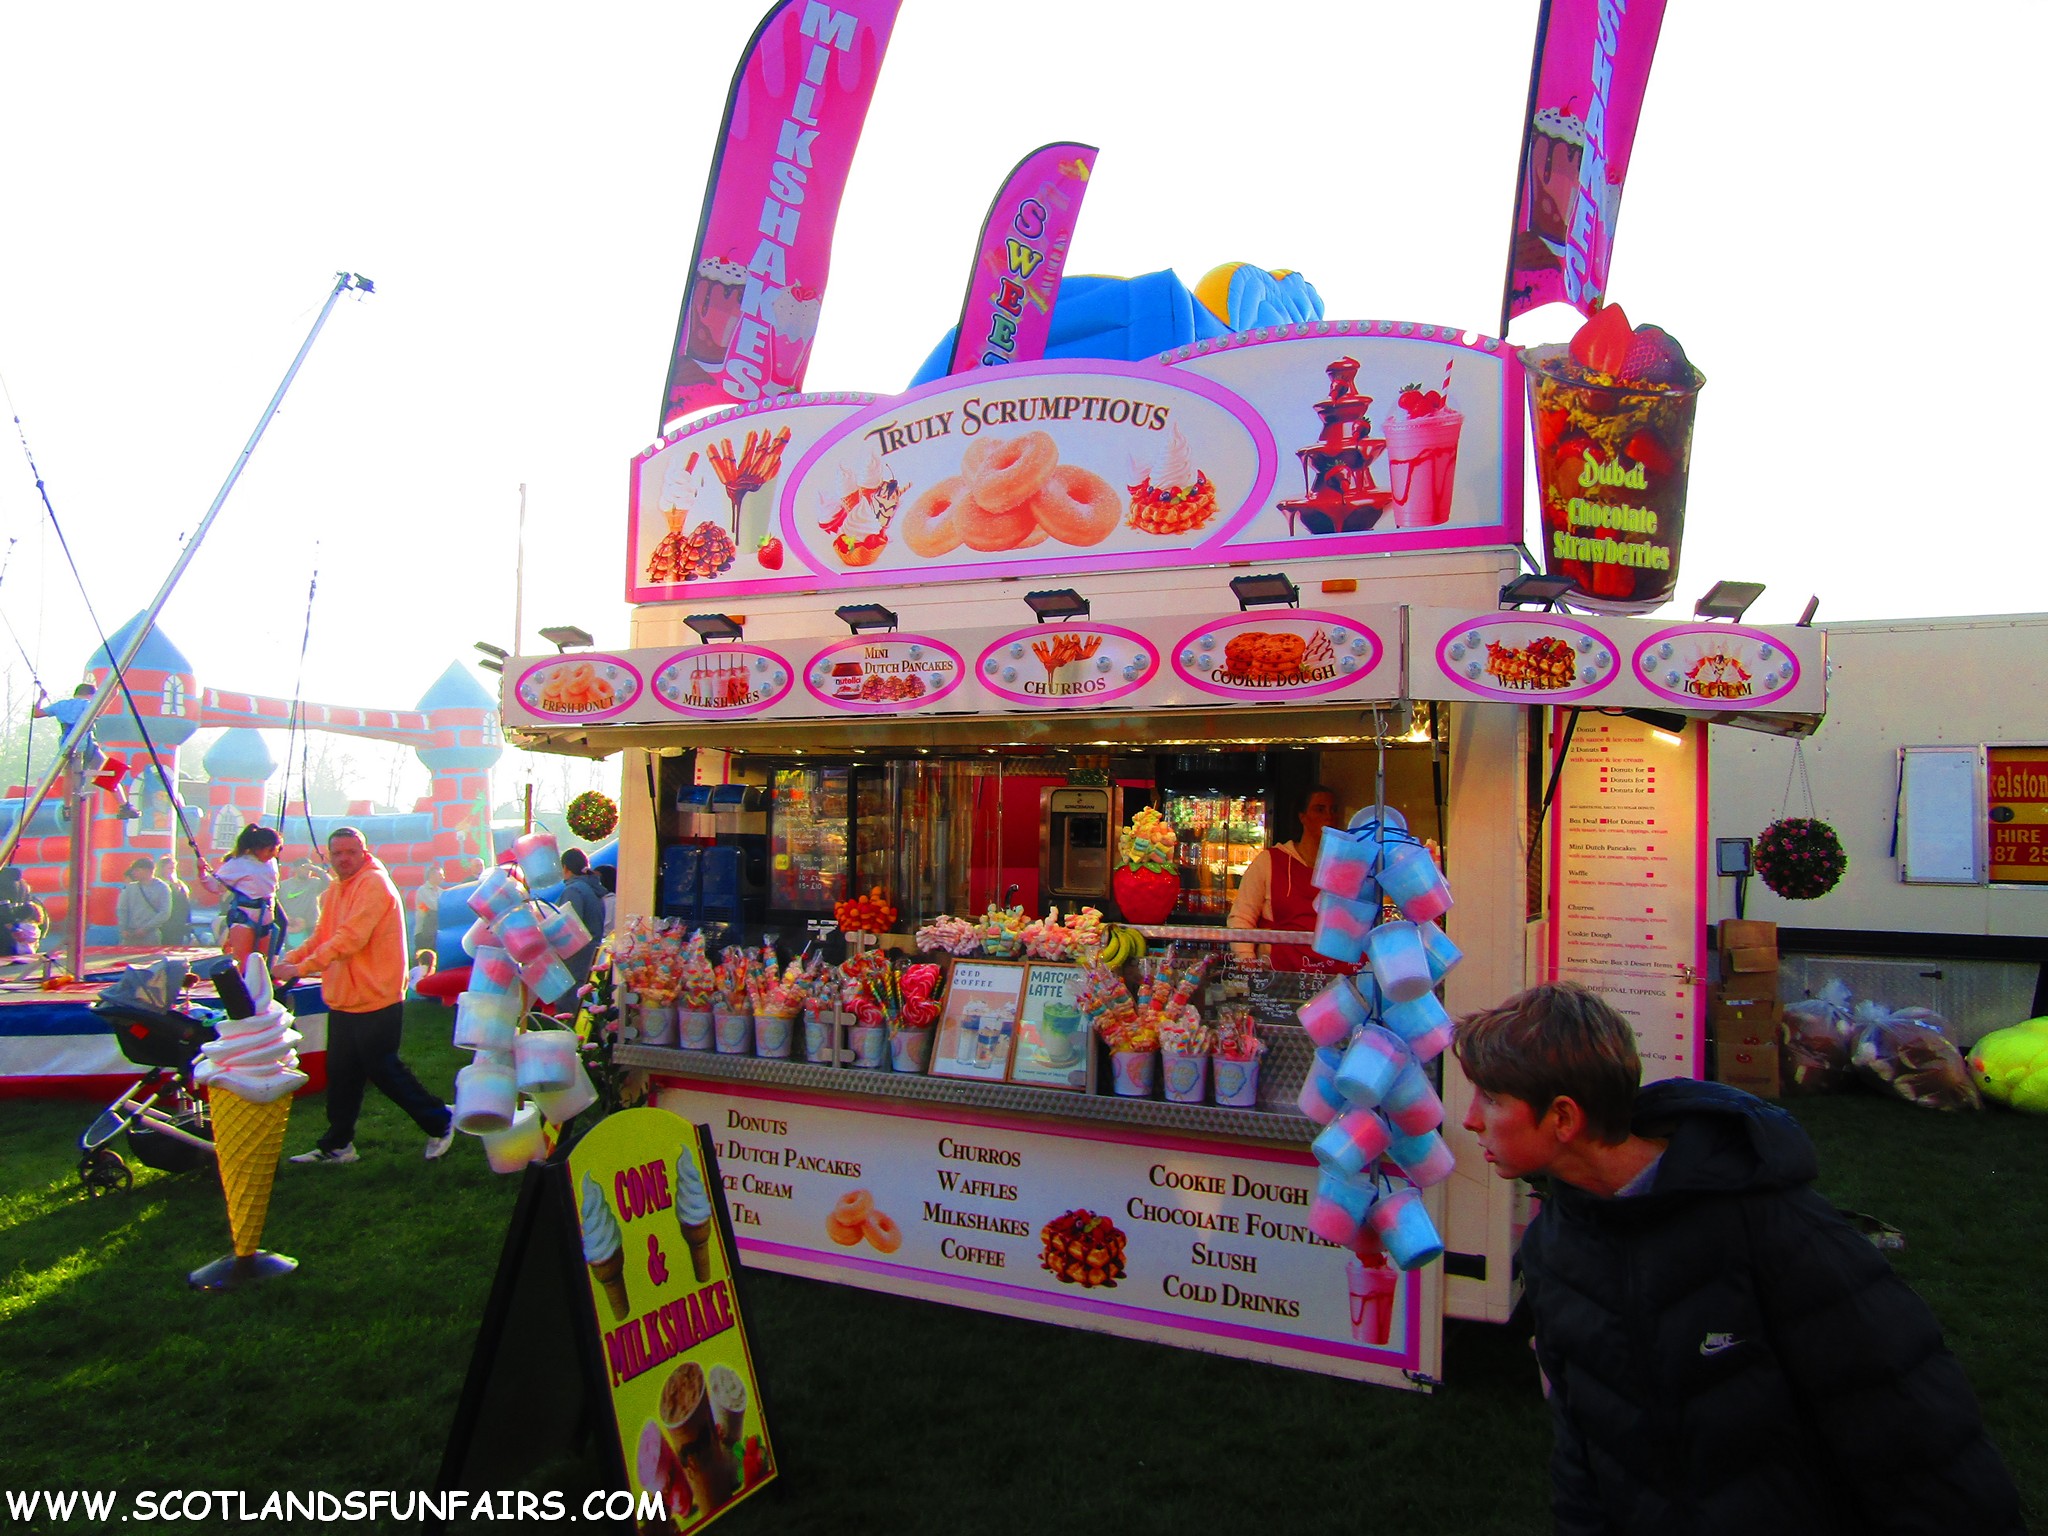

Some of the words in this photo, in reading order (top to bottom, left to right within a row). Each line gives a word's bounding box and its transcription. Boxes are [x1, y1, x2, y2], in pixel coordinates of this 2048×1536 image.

[1564, 0, 1627, 304] SHAKES
[723, 1, 858, 401] MILKSHAKES
[865, 411, 954, 456] TRULY
[961, 396, 1170, 436] SCRUMPTIOUS
[1578, 447, 1648, 490] Dubai
[1568, 497, 1658, 534] Chocolate
[1553, 530, 1670, 570] Strawberries
[864, 662, 899, 674] DUTCH
[901, 660, 953, 673] PANCAKES
[1211, 670, 1272, 688] COOKIE
[1276, 664, 1337, 687] DOUGH
[683, 690, 760, 708] MILKSHAKES
[1024, 677, 1106, 695] CHURROS
[1684, 680, 1706, 695] ICE
[1708, 682, 1753, 697] CREAM
[542, 699, 578, 713] FRESH
[578, 696, 615, 713] DONUT
[1606, 844, 1636, 852] Pancakes
[1997, 829, 2041, 843] HIRE
[1995, 846, 2017, 862] 87
[1567, 904, 1594, 912] Churros
[1567, 930, 1590, 938] Cookie
[1590, 931, 1612, 939] Dough
[1029, 985, 1063, 998] LATTE
[1630, 988, 1666, 997] TOPPINGS
[1652, 1052, 1667, 1060] Cup
[727, 1109, 788, 1135] DONUTS
[728, 1140, 780, 1166] DUTCH
[784, 1148, 861, 1178] PANCAKES
[938, 1137, 1021, 1167] CHURROS
[614, 1159, 672, 1223] CONE
[721, 1170, 738, 1190] CE
[742, 1173, 793, 1199] CREAM
[937, 1171, 1018, 1200] WAFFLES
[1149, 1164, 1226, 1194] COOKIE
[1231, 1175, 1309, 1206] DOUGH
[732, 1202, 761, 1226] TEA
[923, 1201, 1030, 1236] MILKSHAKES
[1127, 1197, 1240, 1234] CHOCOLATE
[1245, 1213, 1341, 1248] FOUNT
[647, 1233, 669, 1286] &
[941, 1237, 1006, 1268] COFFEE
[1192, 1242, 1257, 1274] SLUSH
[1163, 1275, 1217, 1304] COLD
[1221, 1284, 1301, 1317] DRINKS
[605, 1279, 735, 1387] MILKSHAKE
[1706, 1332, 1734, 1346] NIKE
